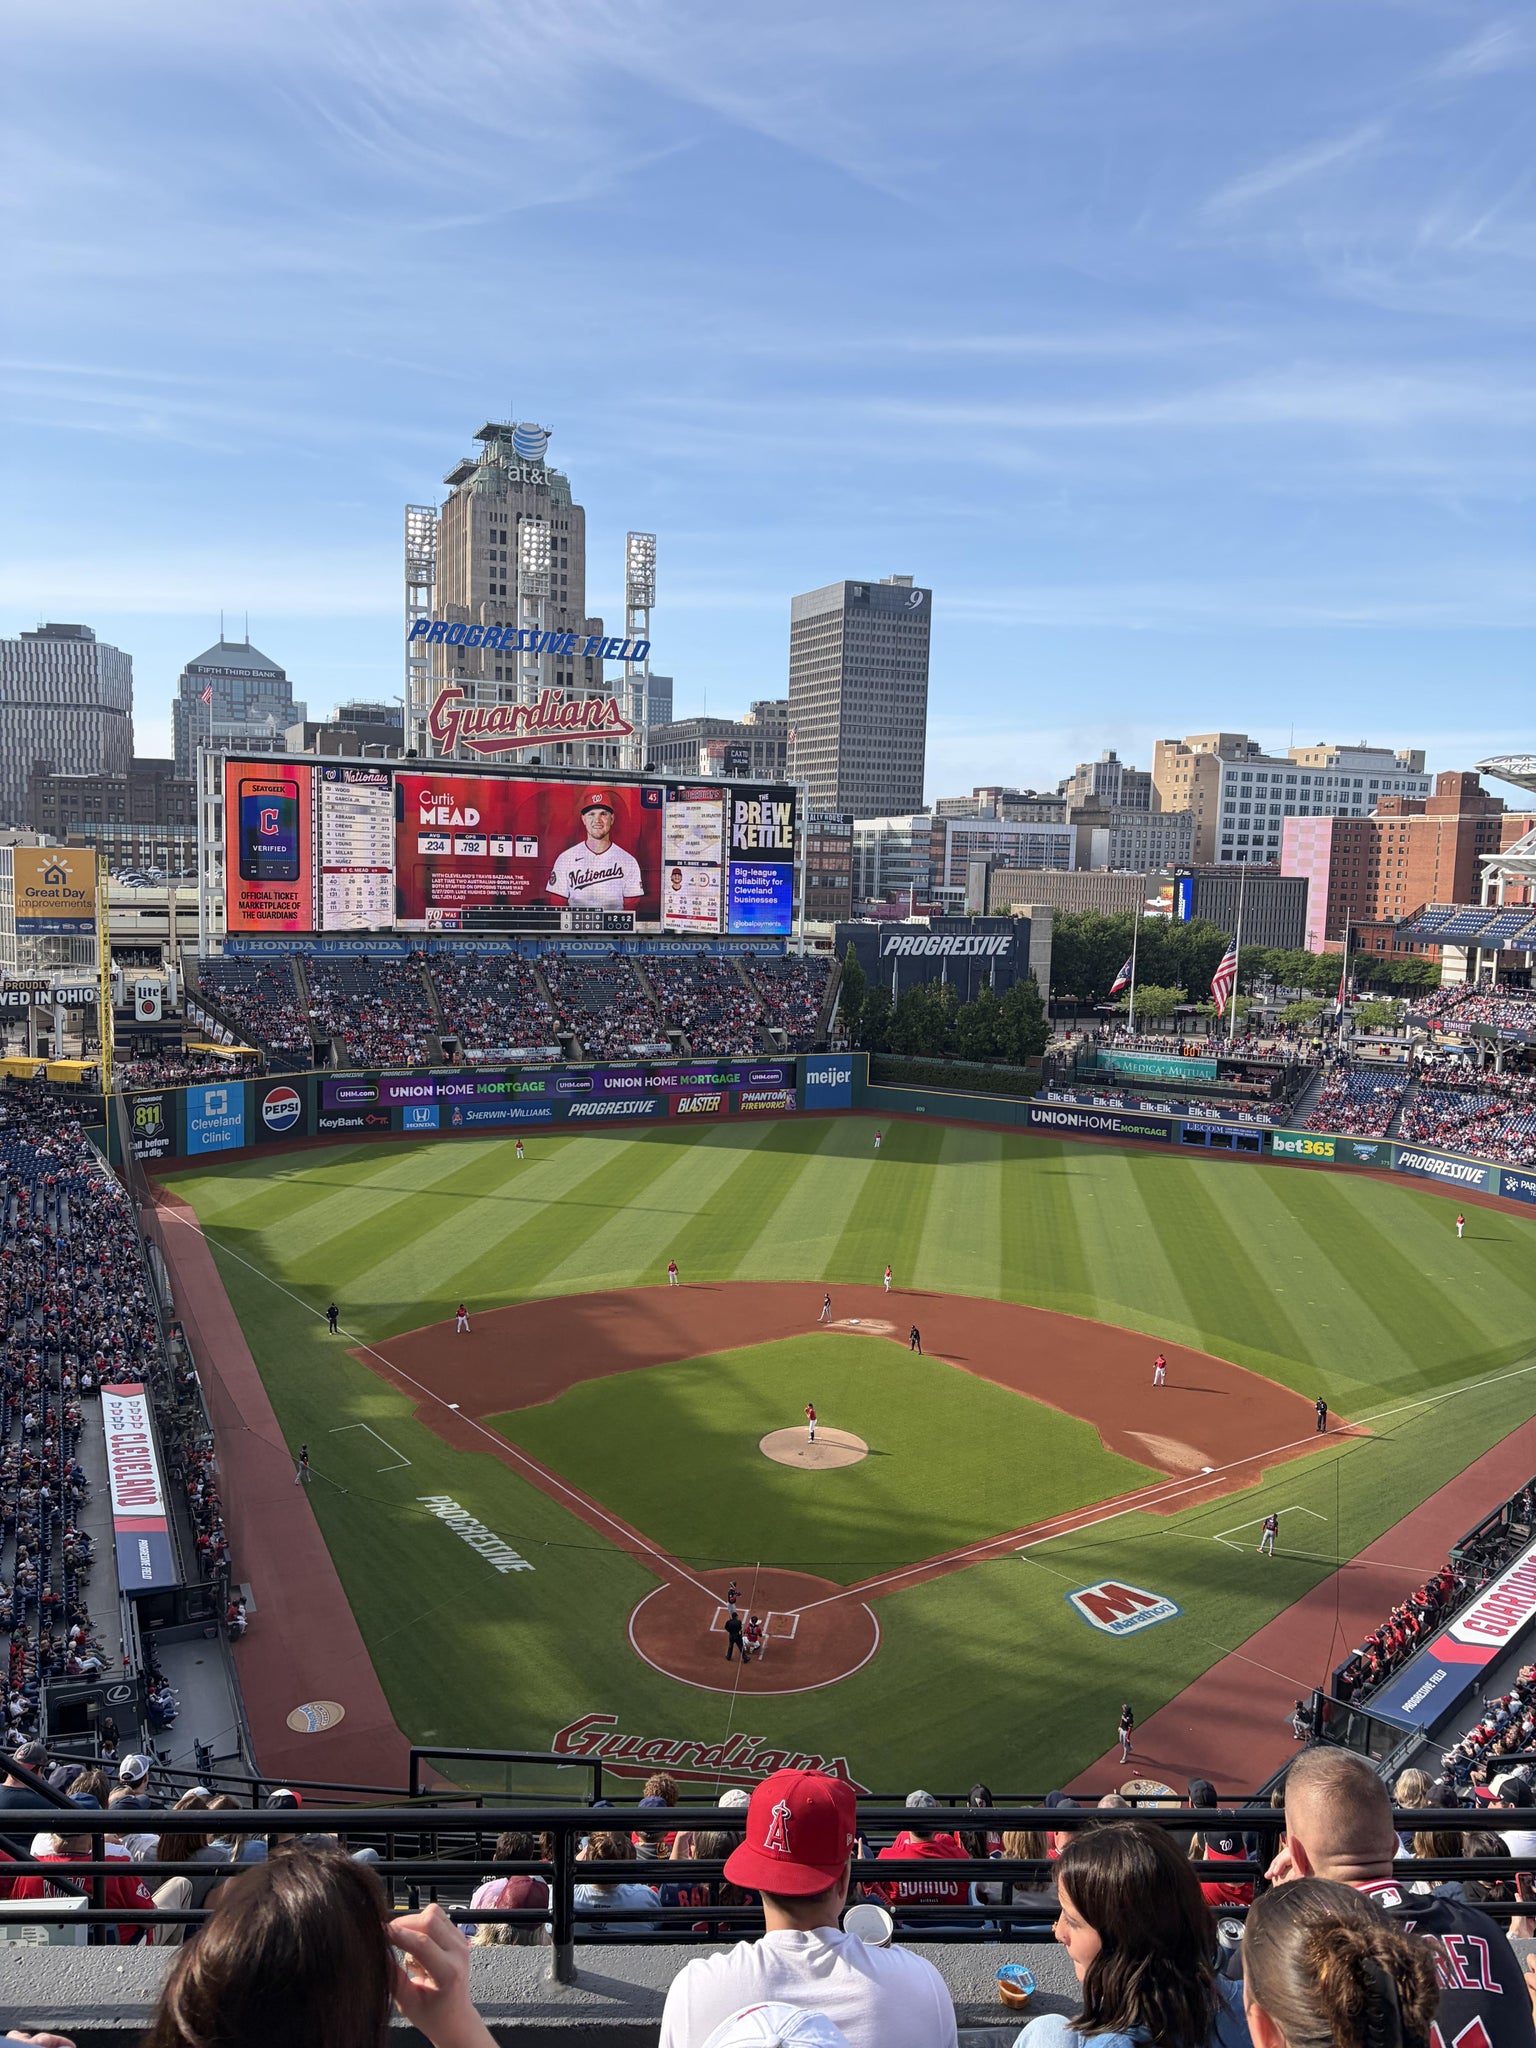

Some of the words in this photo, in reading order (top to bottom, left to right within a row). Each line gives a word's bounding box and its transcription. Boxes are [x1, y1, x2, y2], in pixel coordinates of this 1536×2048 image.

[508, 464, 551, 486] at&t
[904, 591, 923, 610] 9
[408, 619, 580, 656] PROGRESSIVE
[582, 636, 651, 662] FIELD
[198, 666, 222, 674] FIFTH
[224, 667, 250, 676] THIRD
[252, 670, 276, 678] BANK
[428, 687, 636, 756] Guardians
[252, 785, 285, 793] SEATGEEK
[758, 793, 769, 801] THE
[419, 790, 454, 806] Curtis
[419, 805, 481, 827] MEAD
[735, 800, 792, 825] BREW
[260, 808, 279, 835] C
[732, 824, 793, 850] KETTLE
[425, 841, 445, 851] .234
[460, 842, 480, 852] .792
[498, 843, 504, 853] 5
[523, 844, 532, 854] 17
[569, 862, 624, 891] Nationals
[734, 867, 778, 877] Big-league
[734, 877, 771, 887] reliability
[25, 887, 60, 898] Great
[62, 888, 86, 900] Day
[241, 891, 273, 900] OFFICIAL
[274, 892, 299, 900] TICKET
[734, 896, 778, 904] businesses
[18, 899, 92, 909] Improvements
[239, 902, 291, 910] MARKETPLACE
[242, 911, 255, 919] THE
[256, 911, 298, 919] GUARDIANS
[249, 941, 317, 951] HONDA
[336, 941, 404, 951] HONDA
[446, 941, 512, 951] HONDA
[559, 942, 616, 951] HONDA
[661, 942, 712, 951] HONDA
[729, 943, 780, 951] HONDA
[883, 936, 1013, 956] PROGRESSIVE
[4, 980, 51, 991] PROUDLY
[137, 986, 160, 1000] Lite
[35, 990, 52, 1005] IN
[56, 989, 94, 1004] OHIO
[559, 1080, 591, 1088] UHM.com
[604, 1077, 642, 1089] UNION
[645, 1075, 678, 1086] HOME
[680, 1073, 741, 1085] MORTGAGE
[751, 1073, 780, 1081] UHM.com
[806, 1067, 851, 1088] meijer
[389, 1085, 433, 1098] UNION
[436, 1084, 474, 1096] HOME
[477, 1081, 546, 1094] MORTGAGE
[742, 1091, 787, 1102] PHANTOM
[264, 1102, 299, 1116] PEPSI
[568, 1100, 656, 1116] PROGRESSIVE
[677, 1095, 721, 1113] BLASTER
[740, 1101, 786, 1110] FIREWORKS
[135, 1105, 160, 1126] 811
[191, 1114, 241, 1131] Cleveland
[319, 1117, 364, 1129] KeyBank
[201, 1130, 231, 1144] Clinic
[1120, 1124, 1167, 1137] MORTGAGE
[144, 1137, 170, 1149] before
[1273, 1136, 1335, 1156] bet365
[134, 1150, 149, 1161] you
[148, 1147, 164, 1158] dig.
[1398, 1152, 1486, 1184] PROGRESSIVE
[109, 1432, 159, 1507] CLEVELAND
[415, 1495, 537, 1574] PROGRESSIVE
[1462, 1555, 1536, 1637] GUARDIAN
[1108, 1603, 1174, 1632] Marathon
[1401, 1677, 1436, 1713] PROGRESSIVE
[1429, 1668, 1448, 1687] FIELD
[551, 1712, 873, 1795] Guardians
[764, 1799, 792, 1854] A
